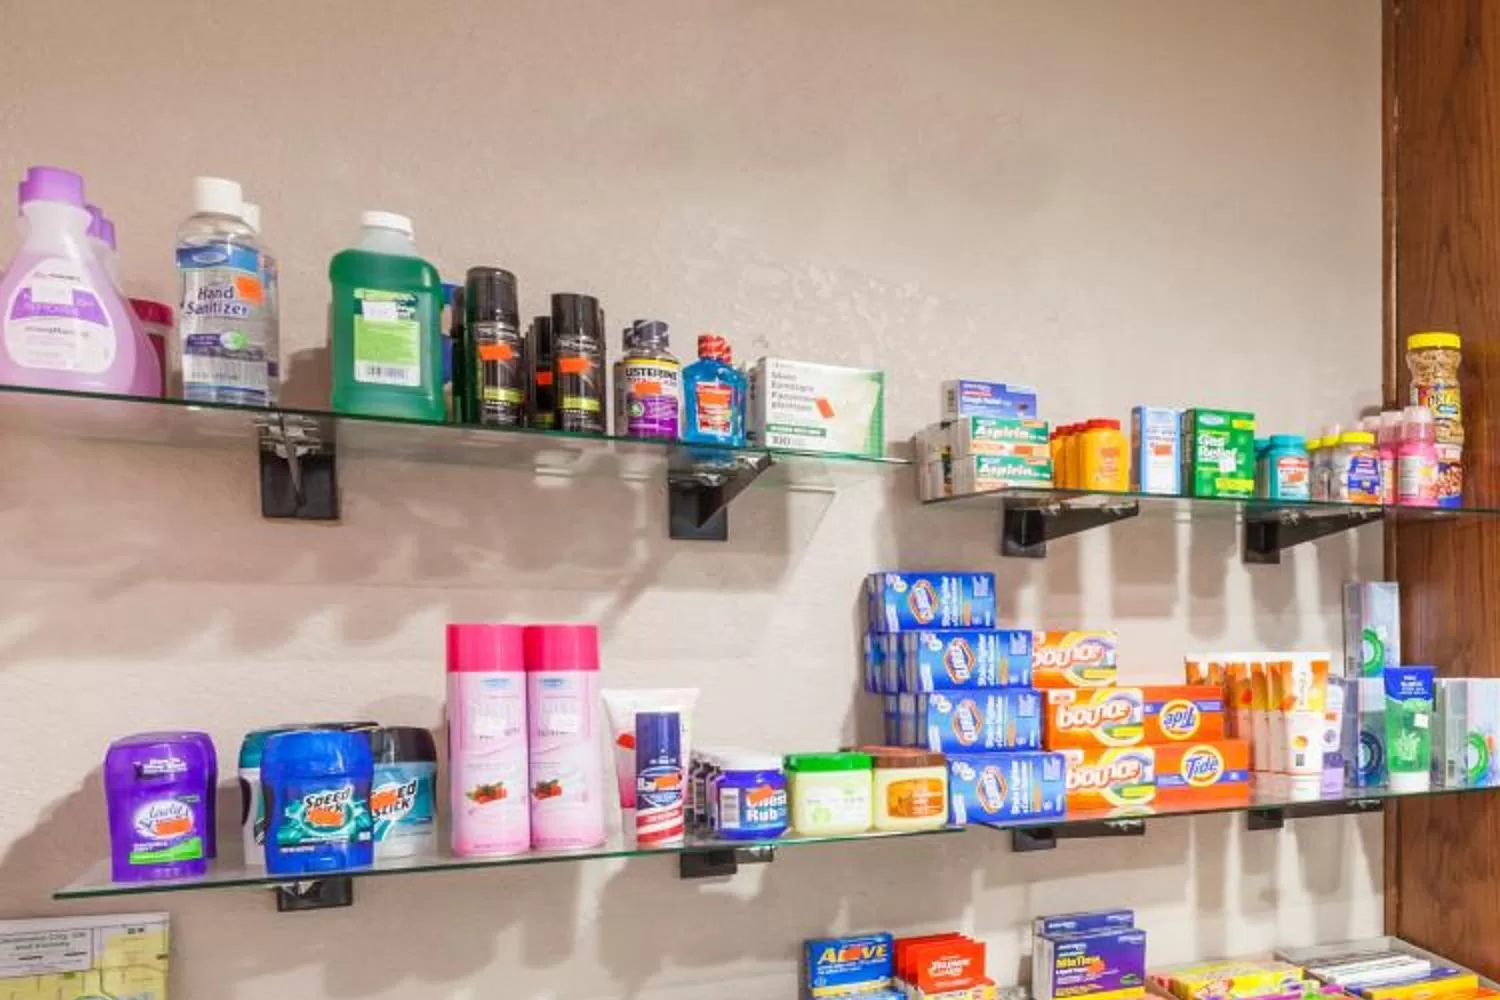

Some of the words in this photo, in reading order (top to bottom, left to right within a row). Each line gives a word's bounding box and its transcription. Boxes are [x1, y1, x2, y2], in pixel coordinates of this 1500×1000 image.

[198, 286, 234, 300] Hand
[1056, 699, 1132, 730] bounce
[1163, 706, 1195, 729] Tide
[1067, 758, 1143, 790] bounce
[1185, 756, 1220, 779] Tide
[745, 808, 779, 822] Rub
[816, 943, 889, 965] ALVE
